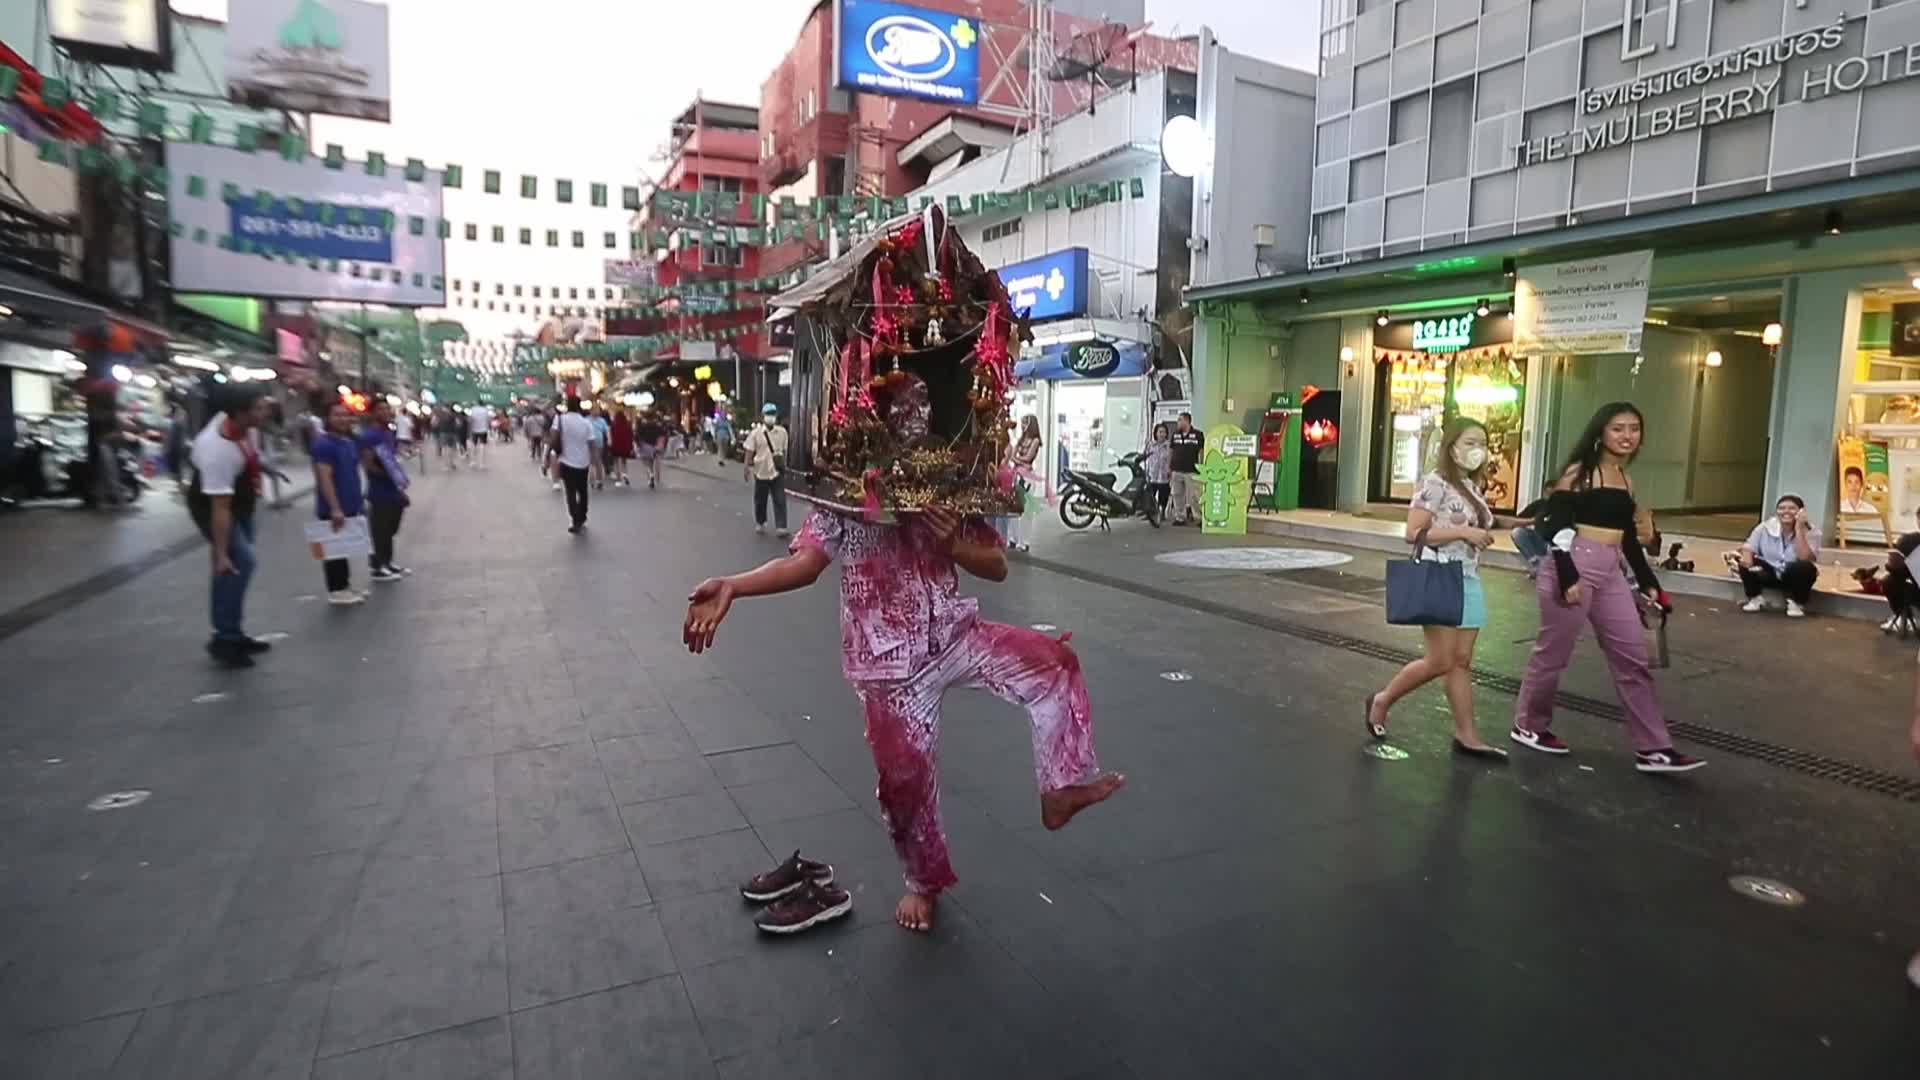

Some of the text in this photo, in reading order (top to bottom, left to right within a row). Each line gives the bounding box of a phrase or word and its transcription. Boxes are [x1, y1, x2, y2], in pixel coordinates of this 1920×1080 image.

[1510, 131, 1568, 168] THE
[1579, 73, 1782, 155] MULBERRY
[1072, 345, 1113, 370] Boots
